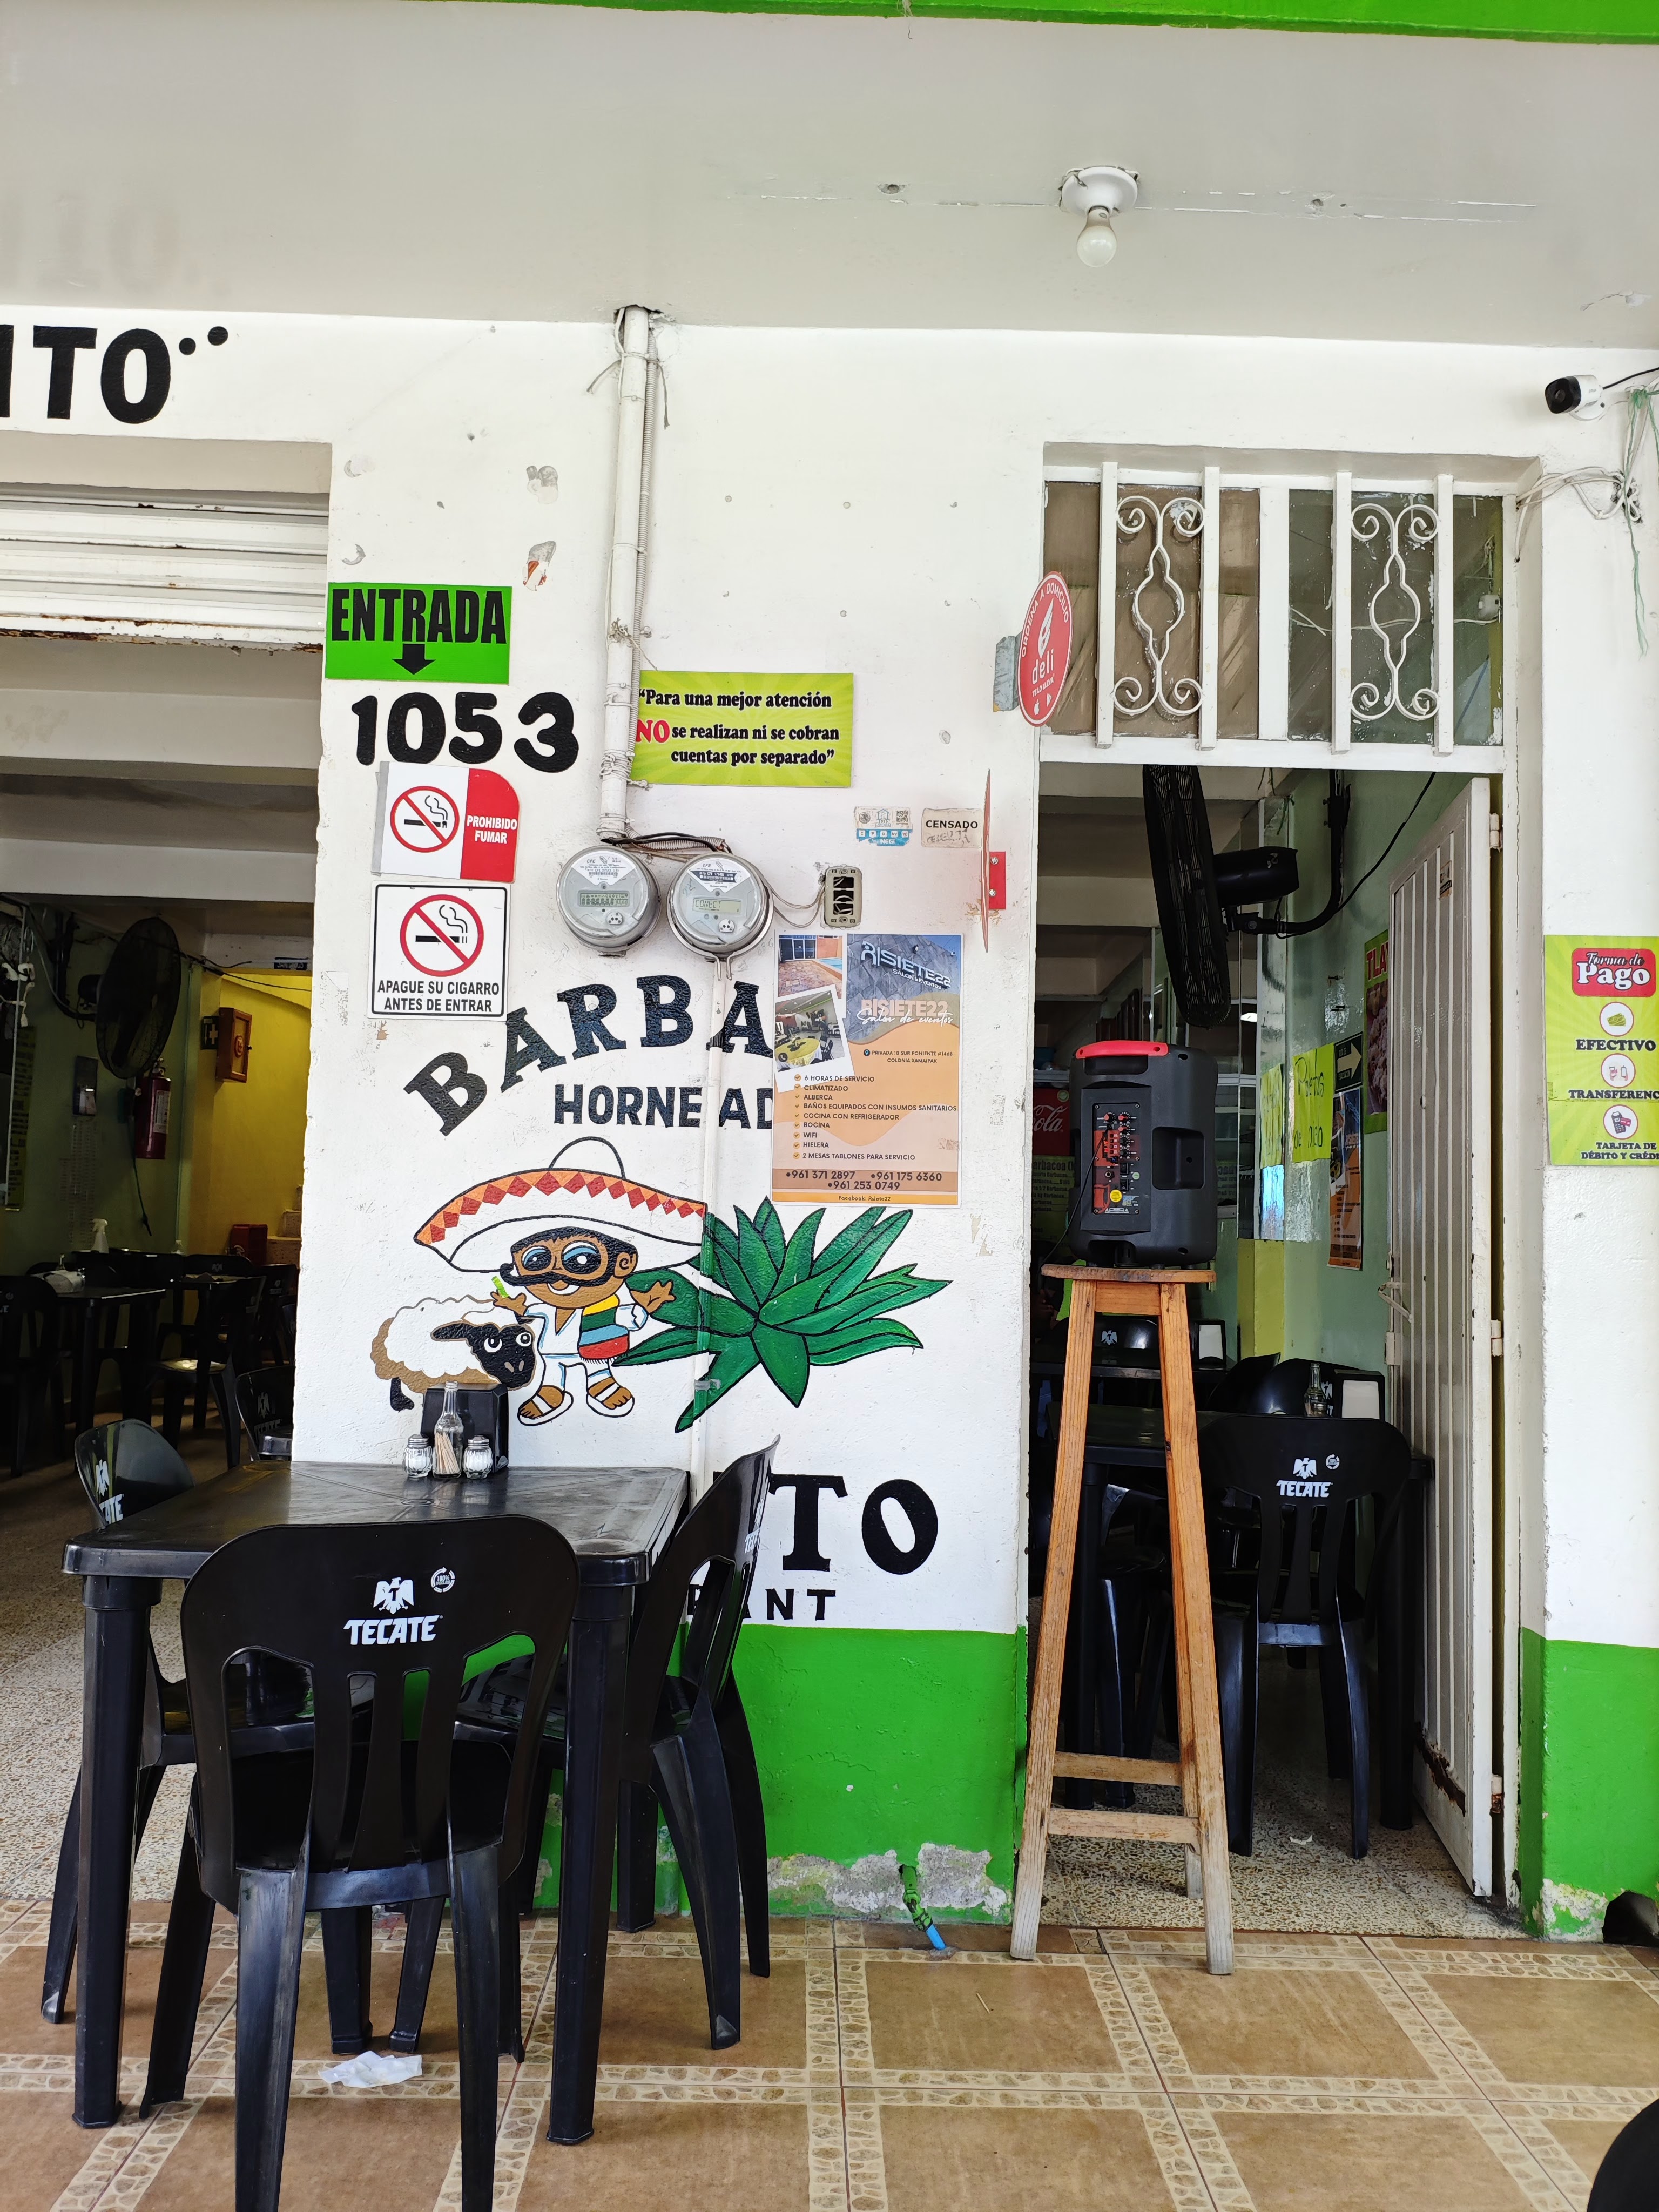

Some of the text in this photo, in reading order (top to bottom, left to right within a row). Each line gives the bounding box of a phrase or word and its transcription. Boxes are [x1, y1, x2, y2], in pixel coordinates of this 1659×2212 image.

[331, 589, 507, 644] ENTRADA
[1022, 582, 1069, 658] ORDENA A DOMICILIO
[1032, 648, 1054, 685] deli
[1032, 688, 1037, 698] TE
[1037, 685, 1042, 694] LO
[684, 694, 713, 706] una
[717, 691, 762, 711] mejor
[766, 691, 832, 707] atención
[351, 692, 579, 773] 1053
[636, 719, 839, 743] NO se realizan ni se cobran
[671, 749, 834, 767] cuentas por separado”
[467, 815, 517, 830] PROHIBIDO
[926, 820, 978, 829] CENSADO
[475, 830, 507, 844] FUMAR
[893, 968, 914, 981] SALON
[919, 978, 942, 990] EVENTOS
[1576, 961, 1651, 991] Pago
[377, 980, 500, 995] APAGUE SU CIGARRO
[384, 997, 492, 1012] ANTES DE ENTRAR
[900, 1009, 914, 1023] de
[919, 1009, 953, 1027] eventos
[1575, 1039, 1656, 1051] EFECTIVO
[1568, 1089, 1659, 1100] TRANSFERENC
[1581, 1150, 1618, 1159] DÉBITO
[812, 1170, 827, 1179] 371
[831, 1171, 855, 1180] 2897
[897, 1172, 913, 1181] 175
[916, 1172, 942, 1181] 6360
[854, 1181, 871, 1190] 253
[875, 1182, 900, 1190] 0749
[1276, 1480, 1331, 1498] TECATE
[712, 1471, 939, 1575] TO
[343, 1615, 440, 1645] TECATE
